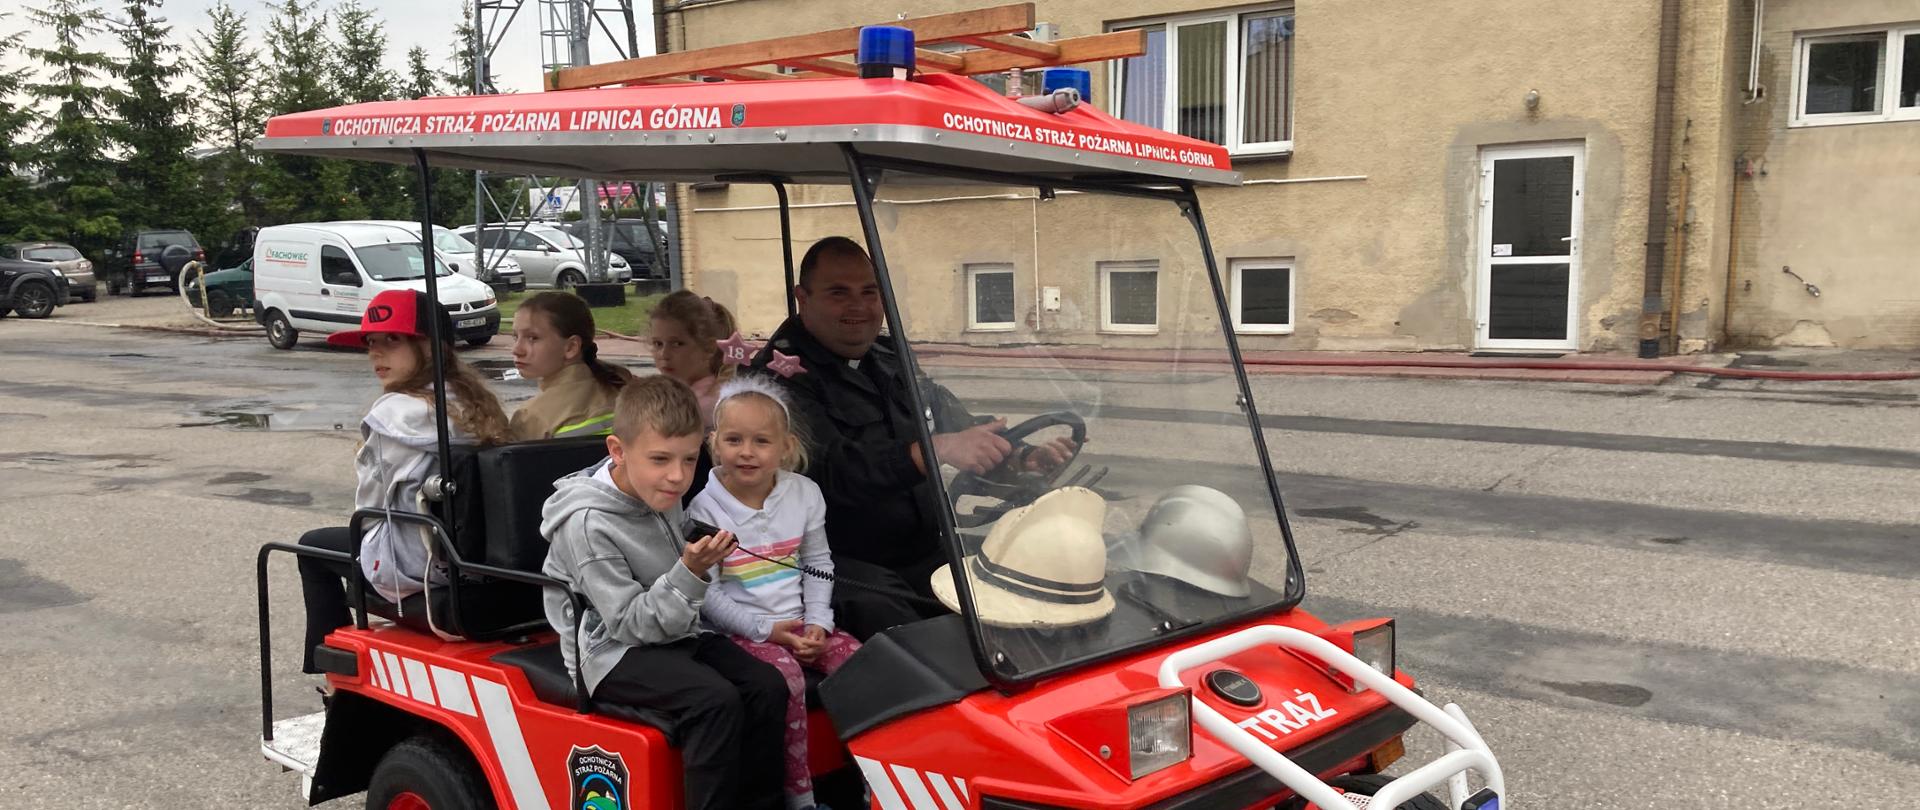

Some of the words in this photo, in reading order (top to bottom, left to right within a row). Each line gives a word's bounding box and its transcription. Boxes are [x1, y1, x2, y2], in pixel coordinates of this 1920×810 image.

[333, 116, 422, 135] OCHOTNICZA
[424, 111, 479, 134] STRAŻ
[481, 109, 561, 132] POŻARNA
[569, 109, 644, 131] LIPNICA
[649, 103, 722, 129] GÓRNA
[943, 112, 1033, 141] OCHOTNICZA
[1034, 127, 1076, 147] STRAŻ
[1078, 133, 1134, 156] POŻARNA
[1135, 142, 1178, 161] LIPNICA
[1179, 148, 1215, 167] GÓRNA
[272, 250, 309, 261] FACHOWIEC
[728, 345, 744, 360] 18
[1236, 688, 1338, 740] TRAŻ
[579, 756, 616, 770] OCHOTNICZA
